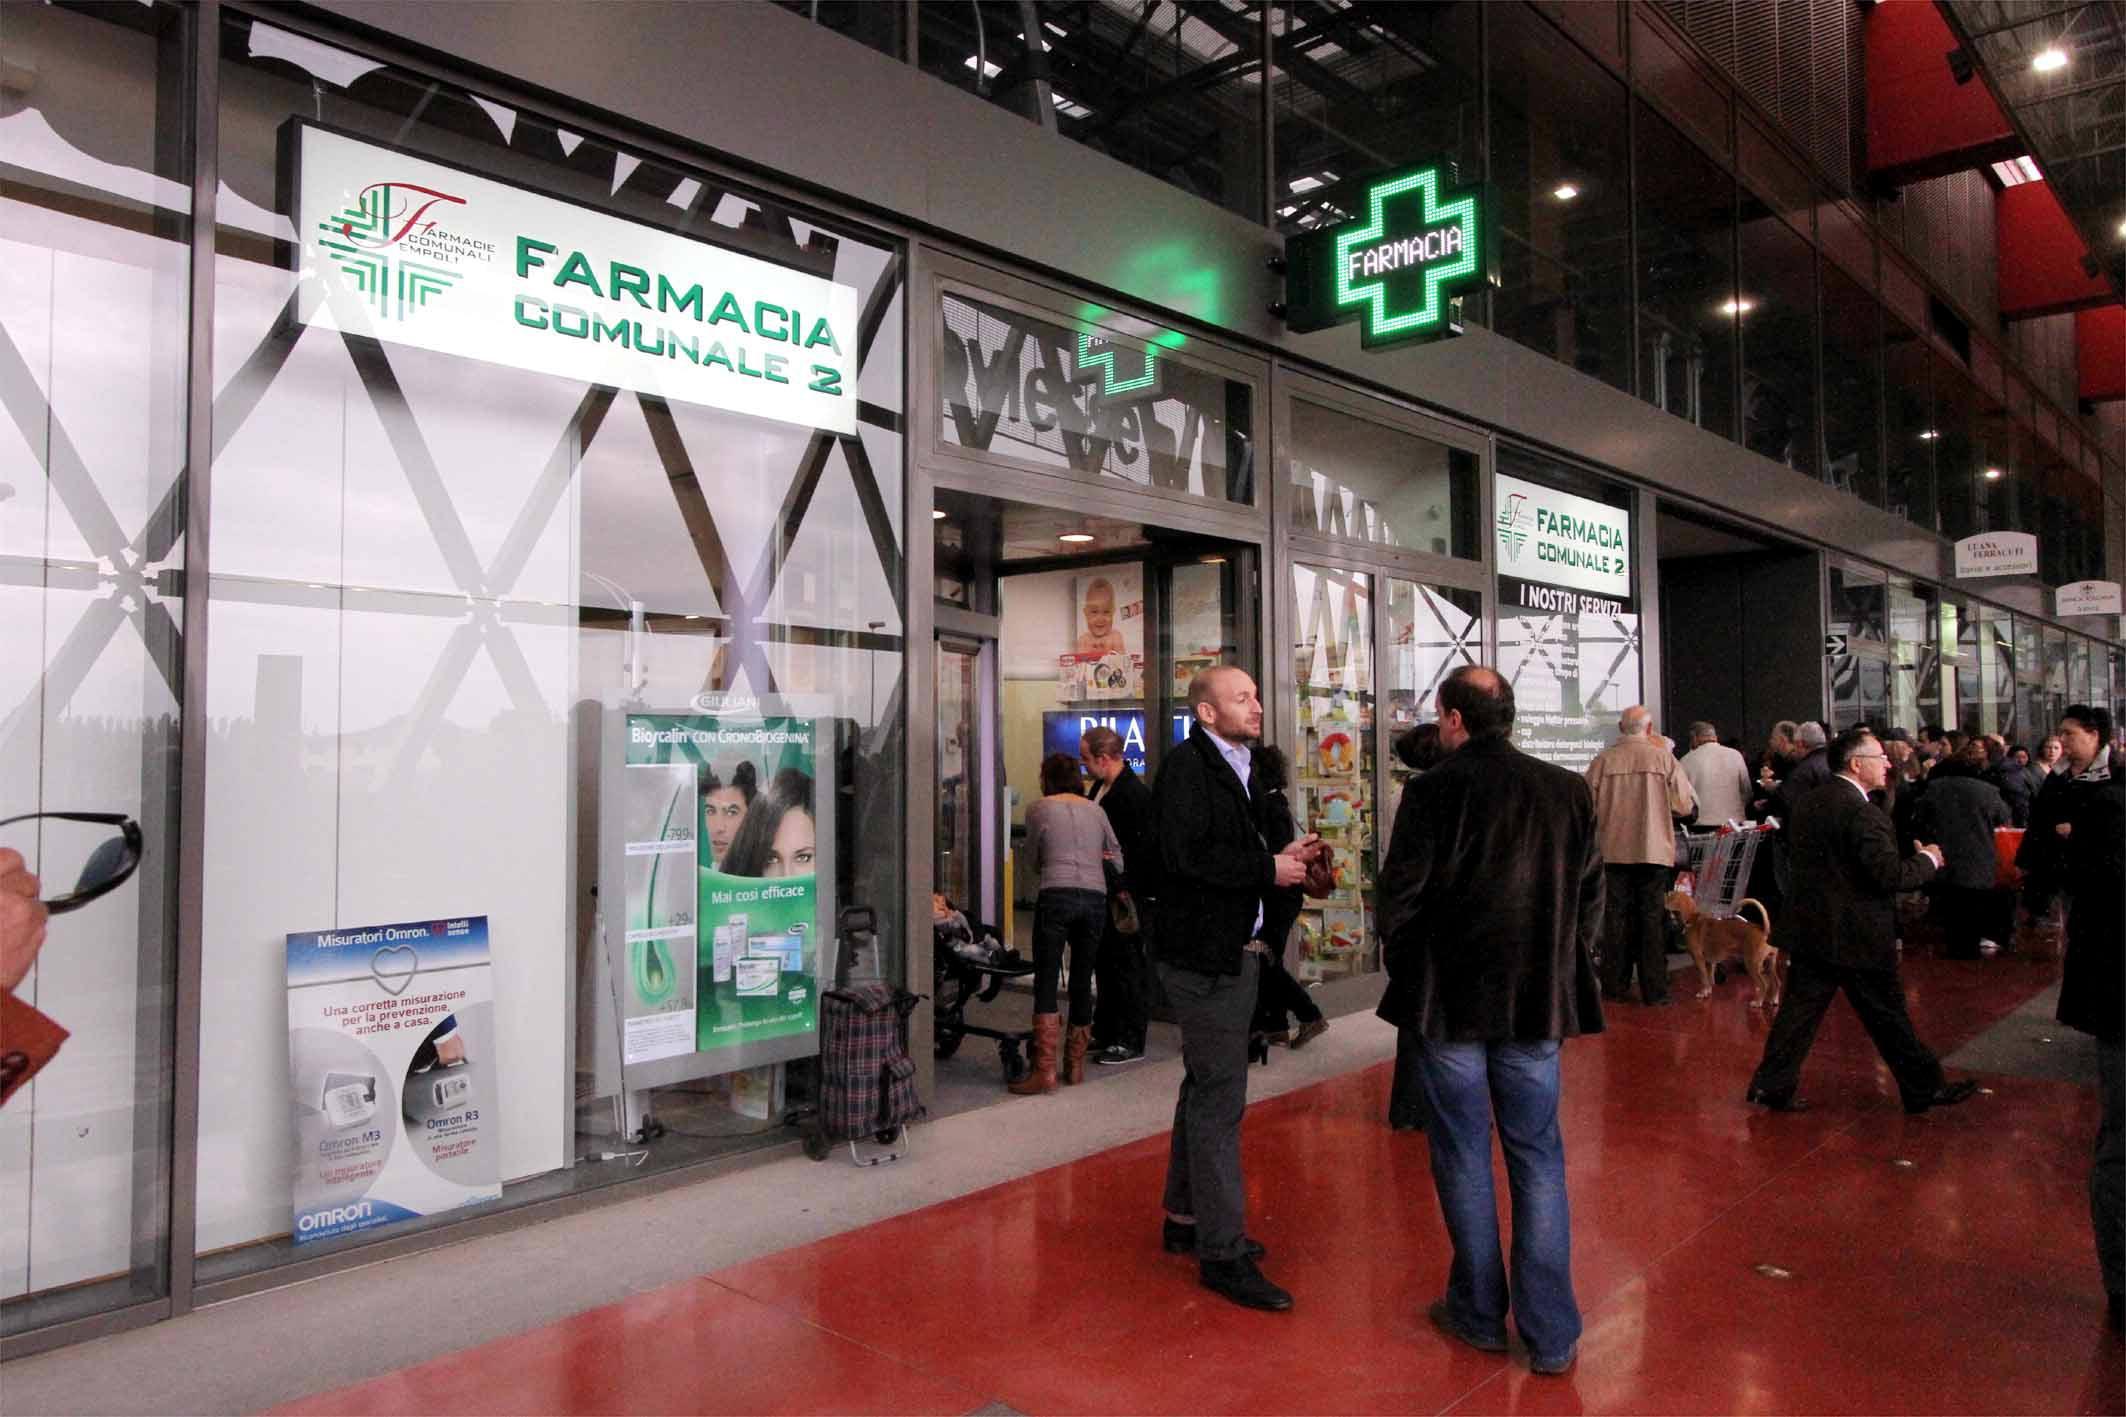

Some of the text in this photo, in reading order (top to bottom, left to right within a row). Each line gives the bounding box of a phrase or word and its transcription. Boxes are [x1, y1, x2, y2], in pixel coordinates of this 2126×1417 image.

[399, 243, 459, 264] EMPOLI
[408, 234, 491, 262] COMUNALI
[1349, 225, 1462, 280] FARMACIA
[515, 235, 843, 357] FARMACIA
[514, 293, 843, 396] COMUNALE 2
[1537, 507, 1624, 552] FARMACIA
[1537, 541, 1625, 577] COMUNALE 2
[1520, 583, 1622, 617] I NOSTRI SERVIZI
[711, 889, 733, 904] Mai
[761, 885, 805, 900] efficace
[317, 927, 430, 949] Misuratori Omron.
[323, 990, 466, 1018] Una corretta misurazione
[342, 1003, 451, 1027] per la prevenzione.
[355, 1017, 433, 1036] anche a casa.
[427, 1110, 479, 1130] Omron R3
[361, 1130, 382, 1144] M3
